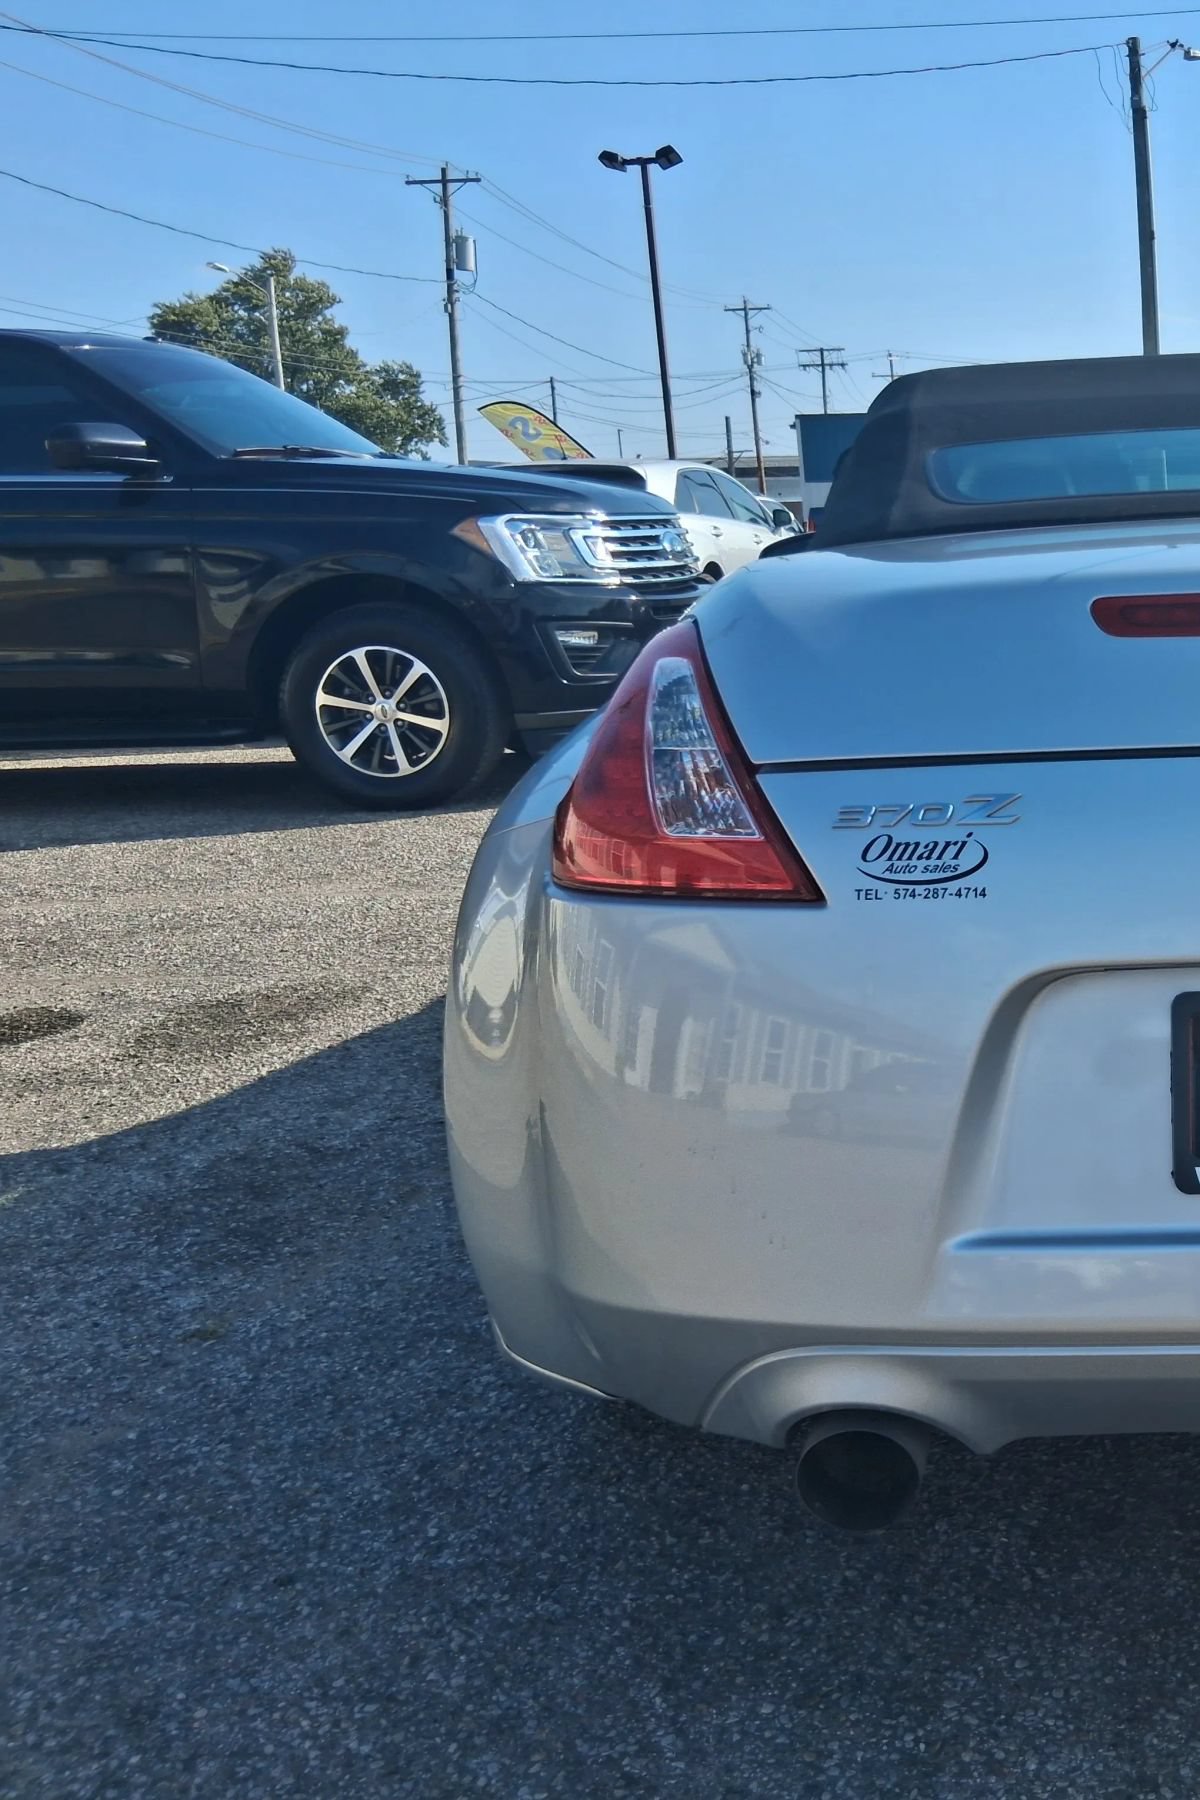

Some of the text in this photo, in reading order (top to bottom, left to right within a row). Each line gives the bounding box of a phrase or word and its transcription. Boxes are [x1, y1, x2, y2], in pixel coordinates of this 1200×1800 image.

[831, 793, 1022, 829] 370Z
[860, 831, 974, 864] Omari
[881, 862, 961, 875] Auto sales
[893, 886, 987, 900] 574-287-4714
